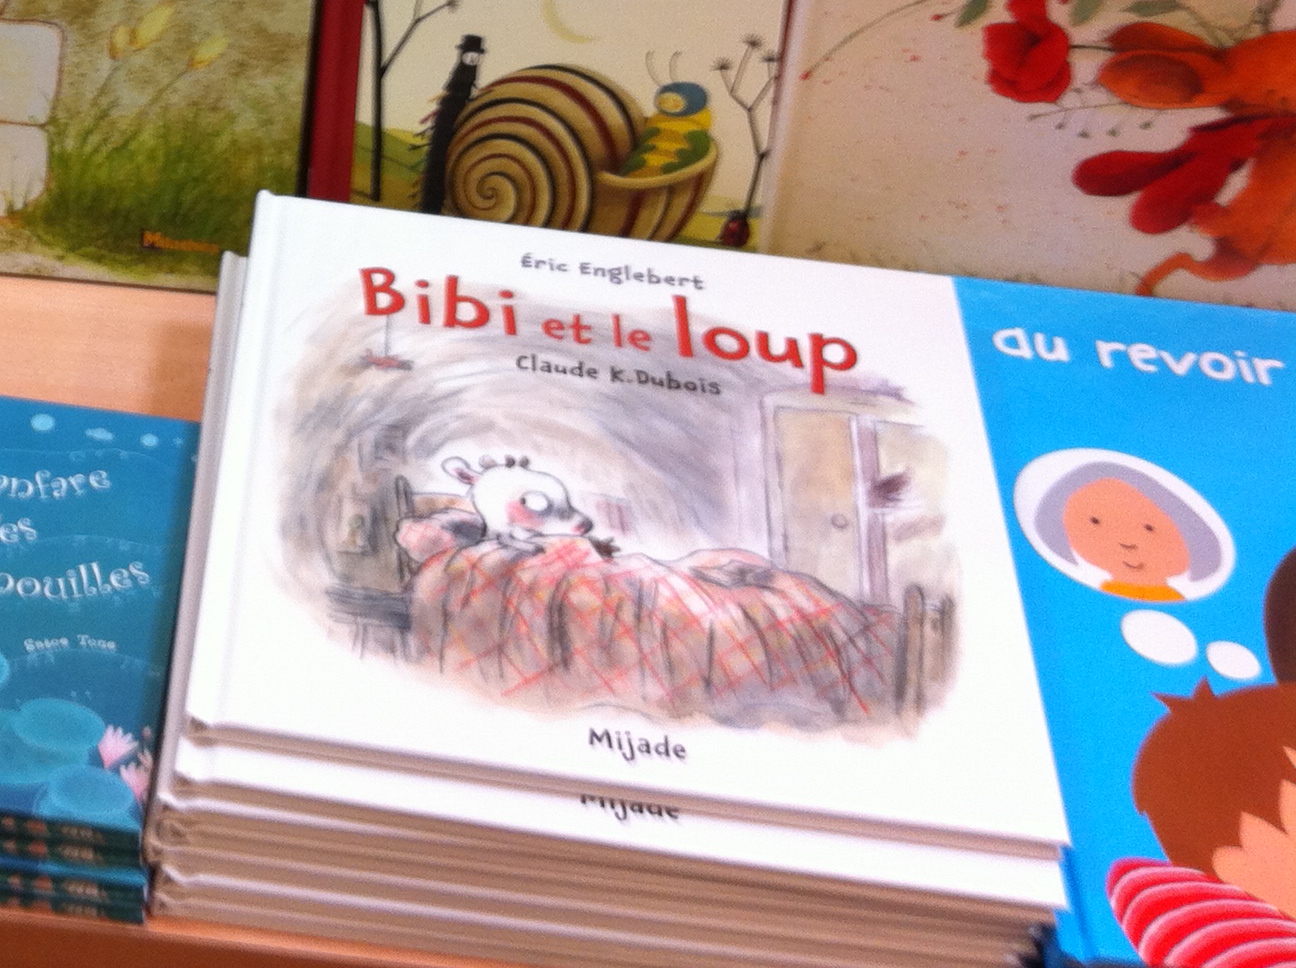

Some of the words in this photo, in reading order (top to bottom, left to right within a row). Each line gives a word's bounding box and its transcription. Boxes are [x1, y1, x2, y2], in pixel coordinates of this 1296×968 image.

[519, 252, 569, 274] Éric
[578, 261, 707, 291] Englebert
[358, 267, 519, 336] Bibi
[540, 313, 593, 346] et
[611, 314, 652, 351] le
[671, 294, 859, 396] loup
[515, 353, 599, 381] Claude
[991, 327, 1071, 363] au
[1095, 339, 1286, 387] revoir
[588, 727, 687, 763] Mijade
